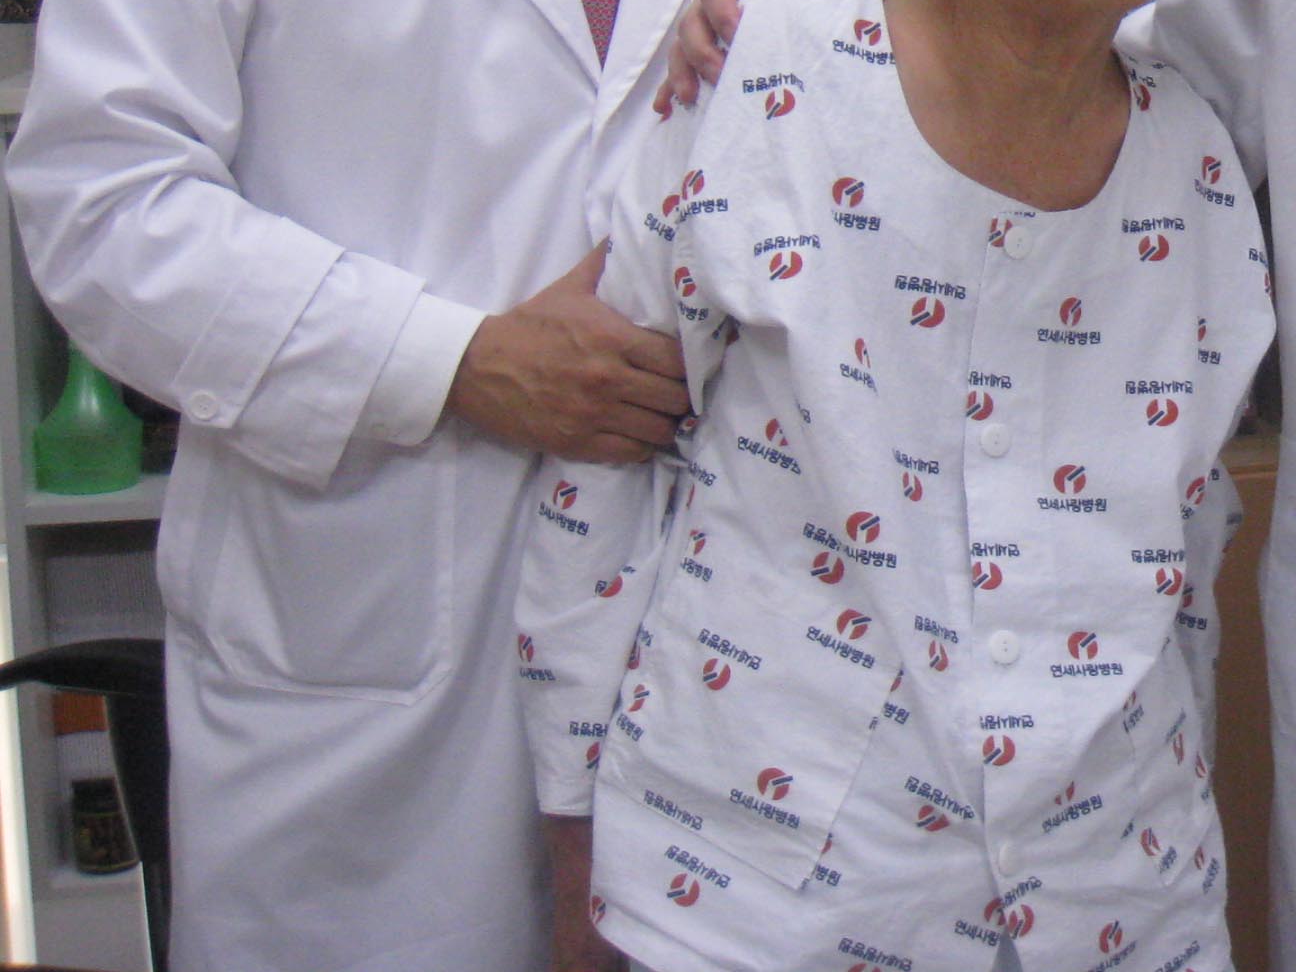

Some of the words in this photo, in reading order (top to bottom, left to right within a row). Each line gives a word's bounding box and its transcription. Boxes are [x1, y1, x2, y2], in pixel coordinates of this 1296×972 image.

[833, 211, 881, 231] 사랑병원
[754, 235, 820, 256] 연세사랑병원
[894, 275, 966, 299] 연세사랑병원
[1037, 328, 1100, 345] 연세사랑병원
[840, 363, 877, 394] 연세사랑
[968, 371, 1012, 388] 연세사랑
[1037, 497, 1107, 512] 연세사랑병원
[845, 544, 897, 568] 사랑병원
[971, 542, 1020, 558] 연세사랑
[1131, 550, 1184, 563] 사랑병원
[698, 628, 763, 671] 연세사랑병원
[806, 626, 876, 669] 연세사랑병원
[1050, 662, 1123, 678] 연세사랑병원
[979, 715, 1034, 730] 연세사랑
[729, 788, 800, 830] 연세사랑병원
[905, 775, 975, 820] 연세사랑병원
[644, 790, 705, 830] 연세사랑병원
[664, 845, 732, 889] 연세사랑병원
[954, 920, 1000, 946] 연세사랑
[838, 936, 912, 972] 연세사랑병원
